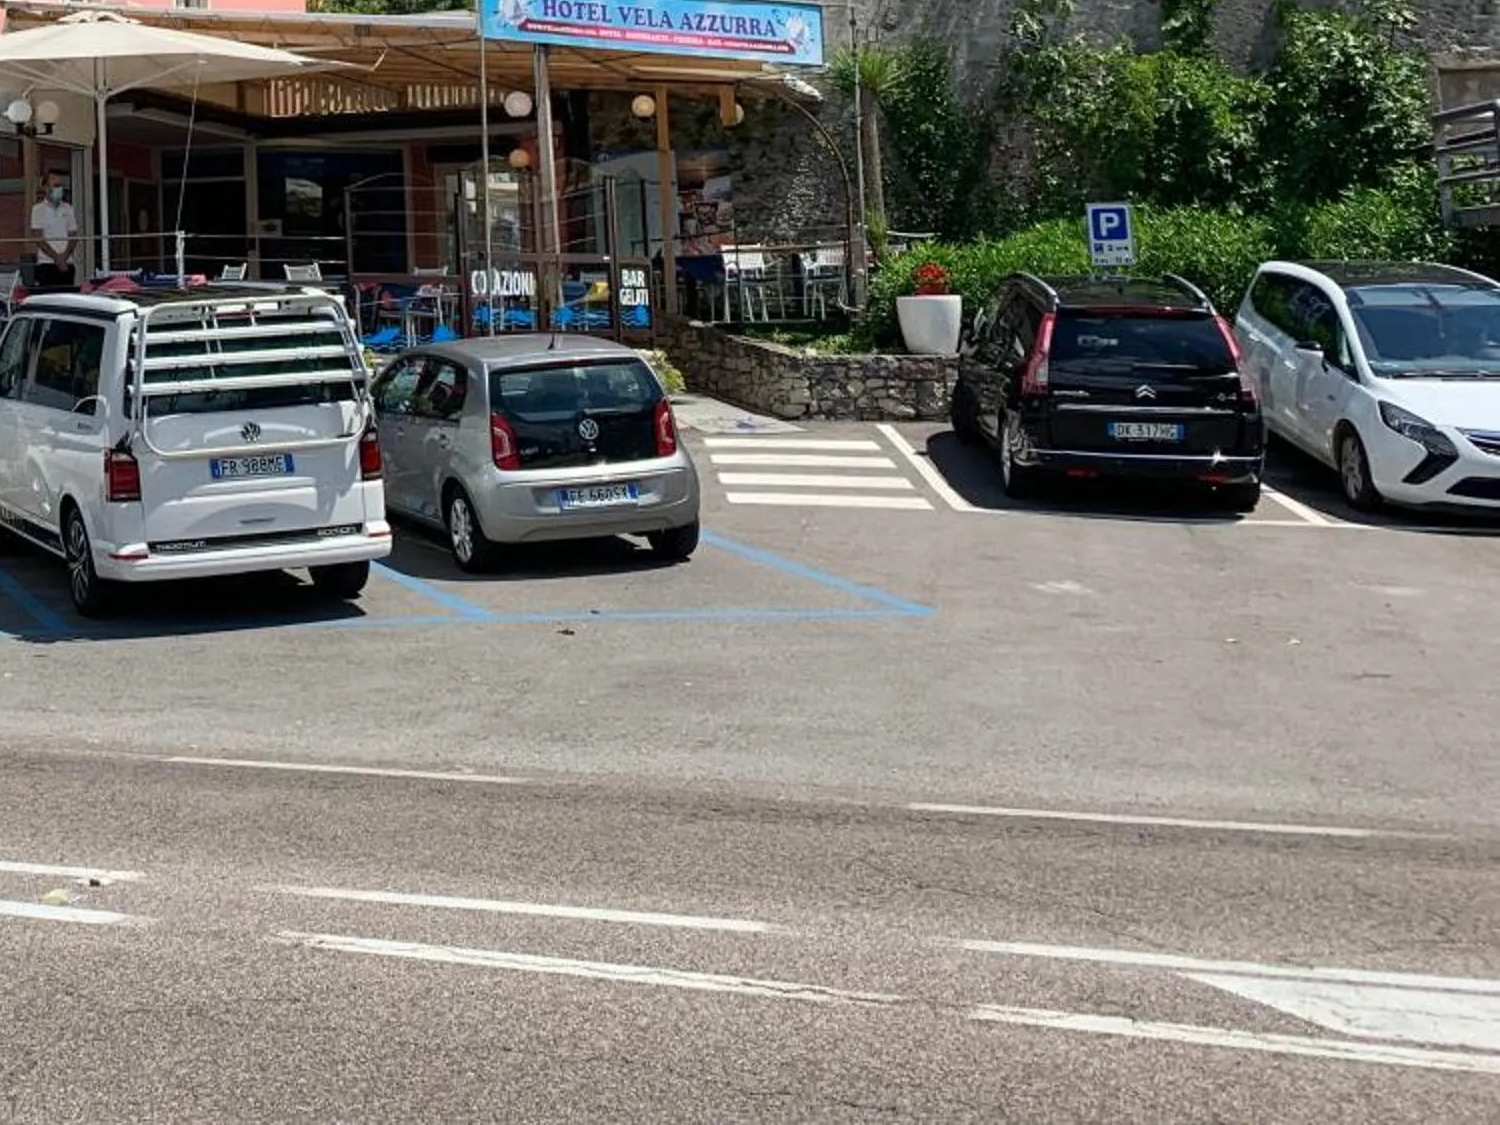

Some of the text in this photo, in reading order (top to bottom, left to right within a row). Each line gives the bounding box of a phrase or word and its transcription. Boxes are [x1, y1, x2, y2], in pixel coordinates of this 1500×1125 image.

[618, 6, 674, 28] VELA
[680, 11, 777, 37] AZZURRA
[1100, 212, 1120, 237] P
[621, 268, 645, 287] BAR
[619, 287, 649, 306] GELATI
